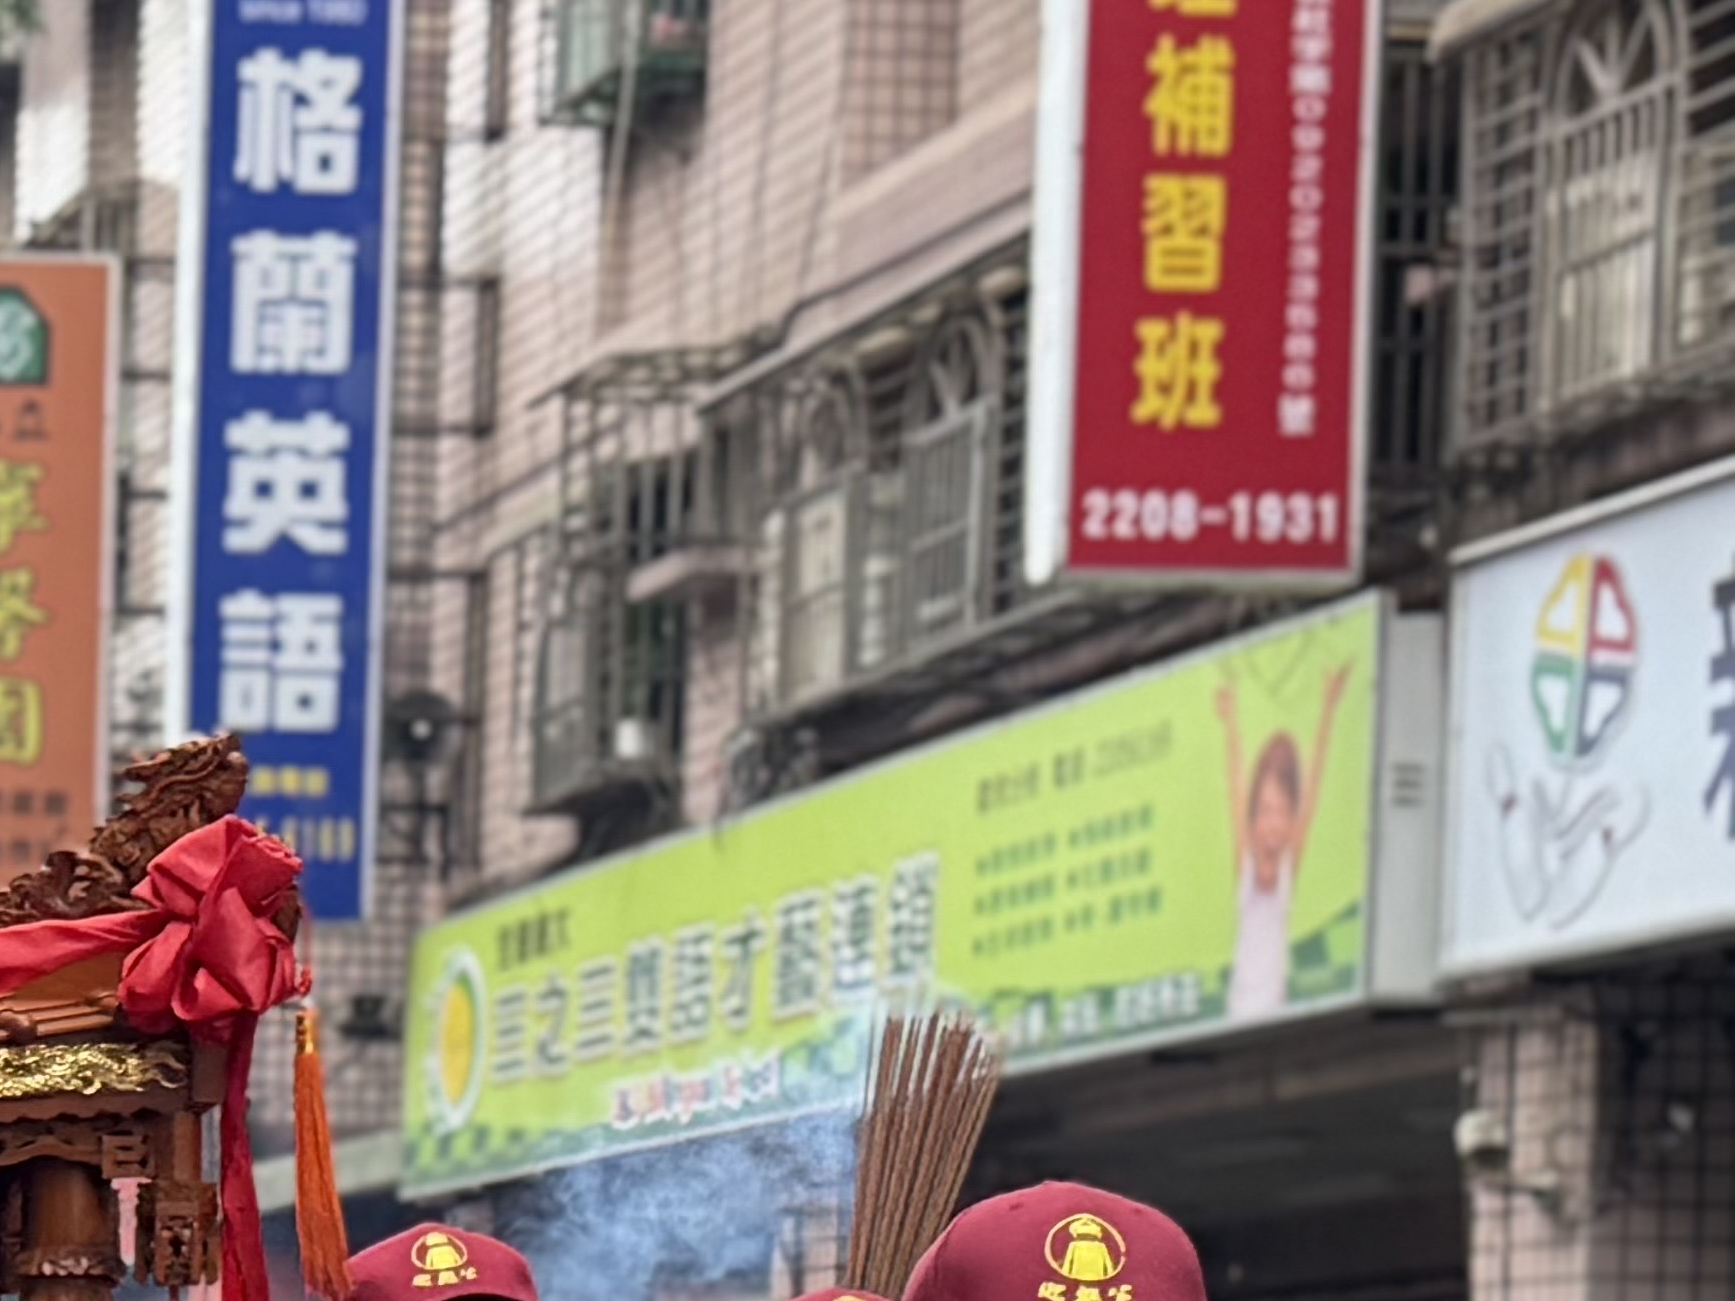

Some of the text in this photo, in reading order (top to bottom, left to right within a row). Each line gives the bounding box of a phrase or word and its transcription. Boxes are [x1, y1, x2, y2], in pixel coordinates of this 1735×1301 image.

[219, 48, 361, 733] 格蘭英語
[1130, 0, 1235, 430] 補習班
[1082, 487, 1339, 544] 2208-1931
